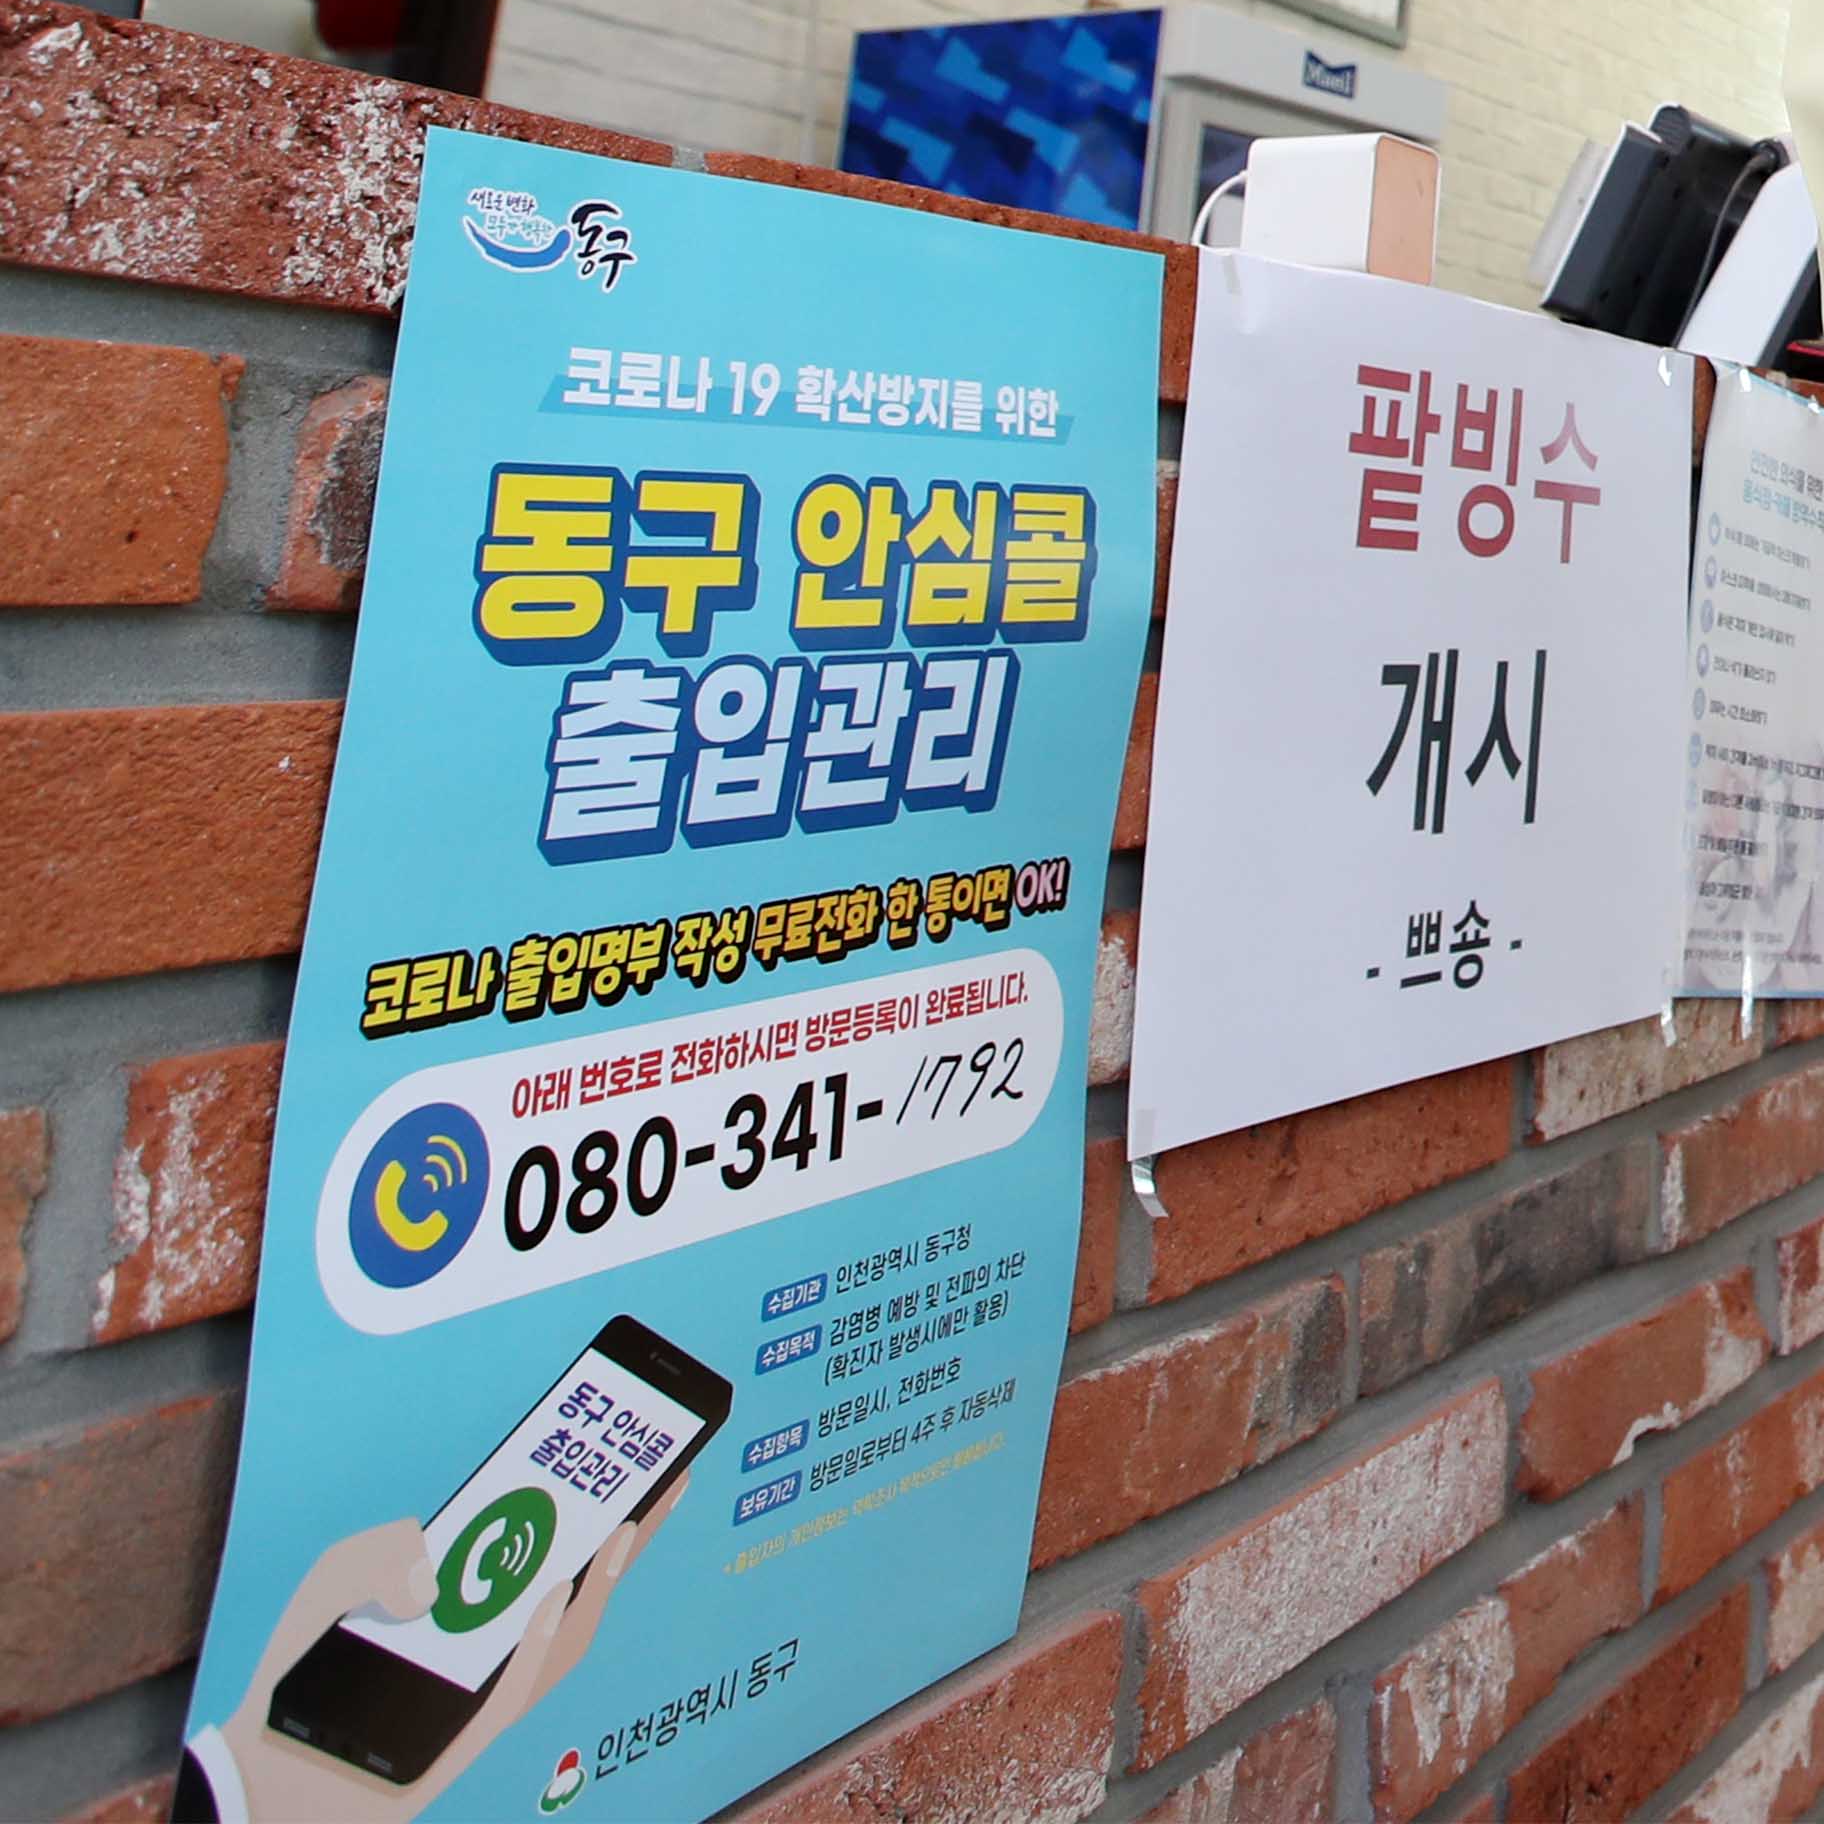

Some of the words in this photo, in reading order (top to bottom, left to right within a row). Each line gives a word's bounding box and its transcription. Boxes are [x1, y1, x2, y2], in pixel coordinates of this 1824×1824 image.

[572, 203, 635, 289] 동구
[561, 346, 713, 414] 코로나
[728, 361, 781, 418] 19
[795, 365, 983, 435] 확산방지를
[995, 386, 1060, 438] 위한
[1347, 363, 1601, 565] 팥빙수
[478, 468, 750, 650] 동구
[785, 478, 1092, 638] 안심콜
[540, 654, 1014, 848] 출입관리
[1365, 648, 1547, 835] 개시
[364, 948, 494, 1031] 코로나
[506, 925, 666, 1011] 출입명부
[673, 907, 748, 976] 작성
[754, 889, 879, 961] 무료전화
[885, 878, 918, 930] 한
[926, 864, 1011, 925] 통이면
[1015, 858, 1068, 908] OK!
[1399, 899, 1491, 990] 쁘숑
[511, 1069, 571, 1119] 아래
[579, 1055, 663, 1106] 번호로
[670, 1019, 799, 1087] 전화하시면
[805, 994, 919, 1055] 방문등록이
[925, 971, 1030, 1025] 완료됩니다.
[762, 1331, 816, 1368] 수집목적
[830, 1304, 881, 1347] 감염병
[888, 1291, 920, 1324] 예방
[926, 1282, 940, 1309] 및
[945, 1264, 991, 1303] 전파의
[995, 1251, 1026, 1282] 차단
[766, 1280, 823, 1314] 수집기관
[836, 1242, 919, 1294] 인천광역시
[925, 1224, 972, 1262] 동구청
[825, 1340, 882, 1386] (확진자
[889, 1309, 969, 1359] 발생시에만
[974, 1290, 1009, 1327] 활용)
[529, 1428, 631, 1503] 출입관리
[558, 1381, 615, 1428] 동구
[600, 1410, 675, 1471] 안심콜
[740, 1476, 796, 1518] 보유기간
[810, 1426, 906, 1492] 방문일로부터
[911, 1414, 937, 1444] 4주
[941, 1407, 954, 1430] 후
[958, 1377, 1016, 1424] 자동삭제
[748, 1424, 803, 1465] 수집항목
[818, 1386, 891, 1438] 방문일시,
[898, 1356, 961, 1405] 전화번호
[595, 1668, 739, 1783] 인천광역시
[744, 1638, 802, 1709] 동구
